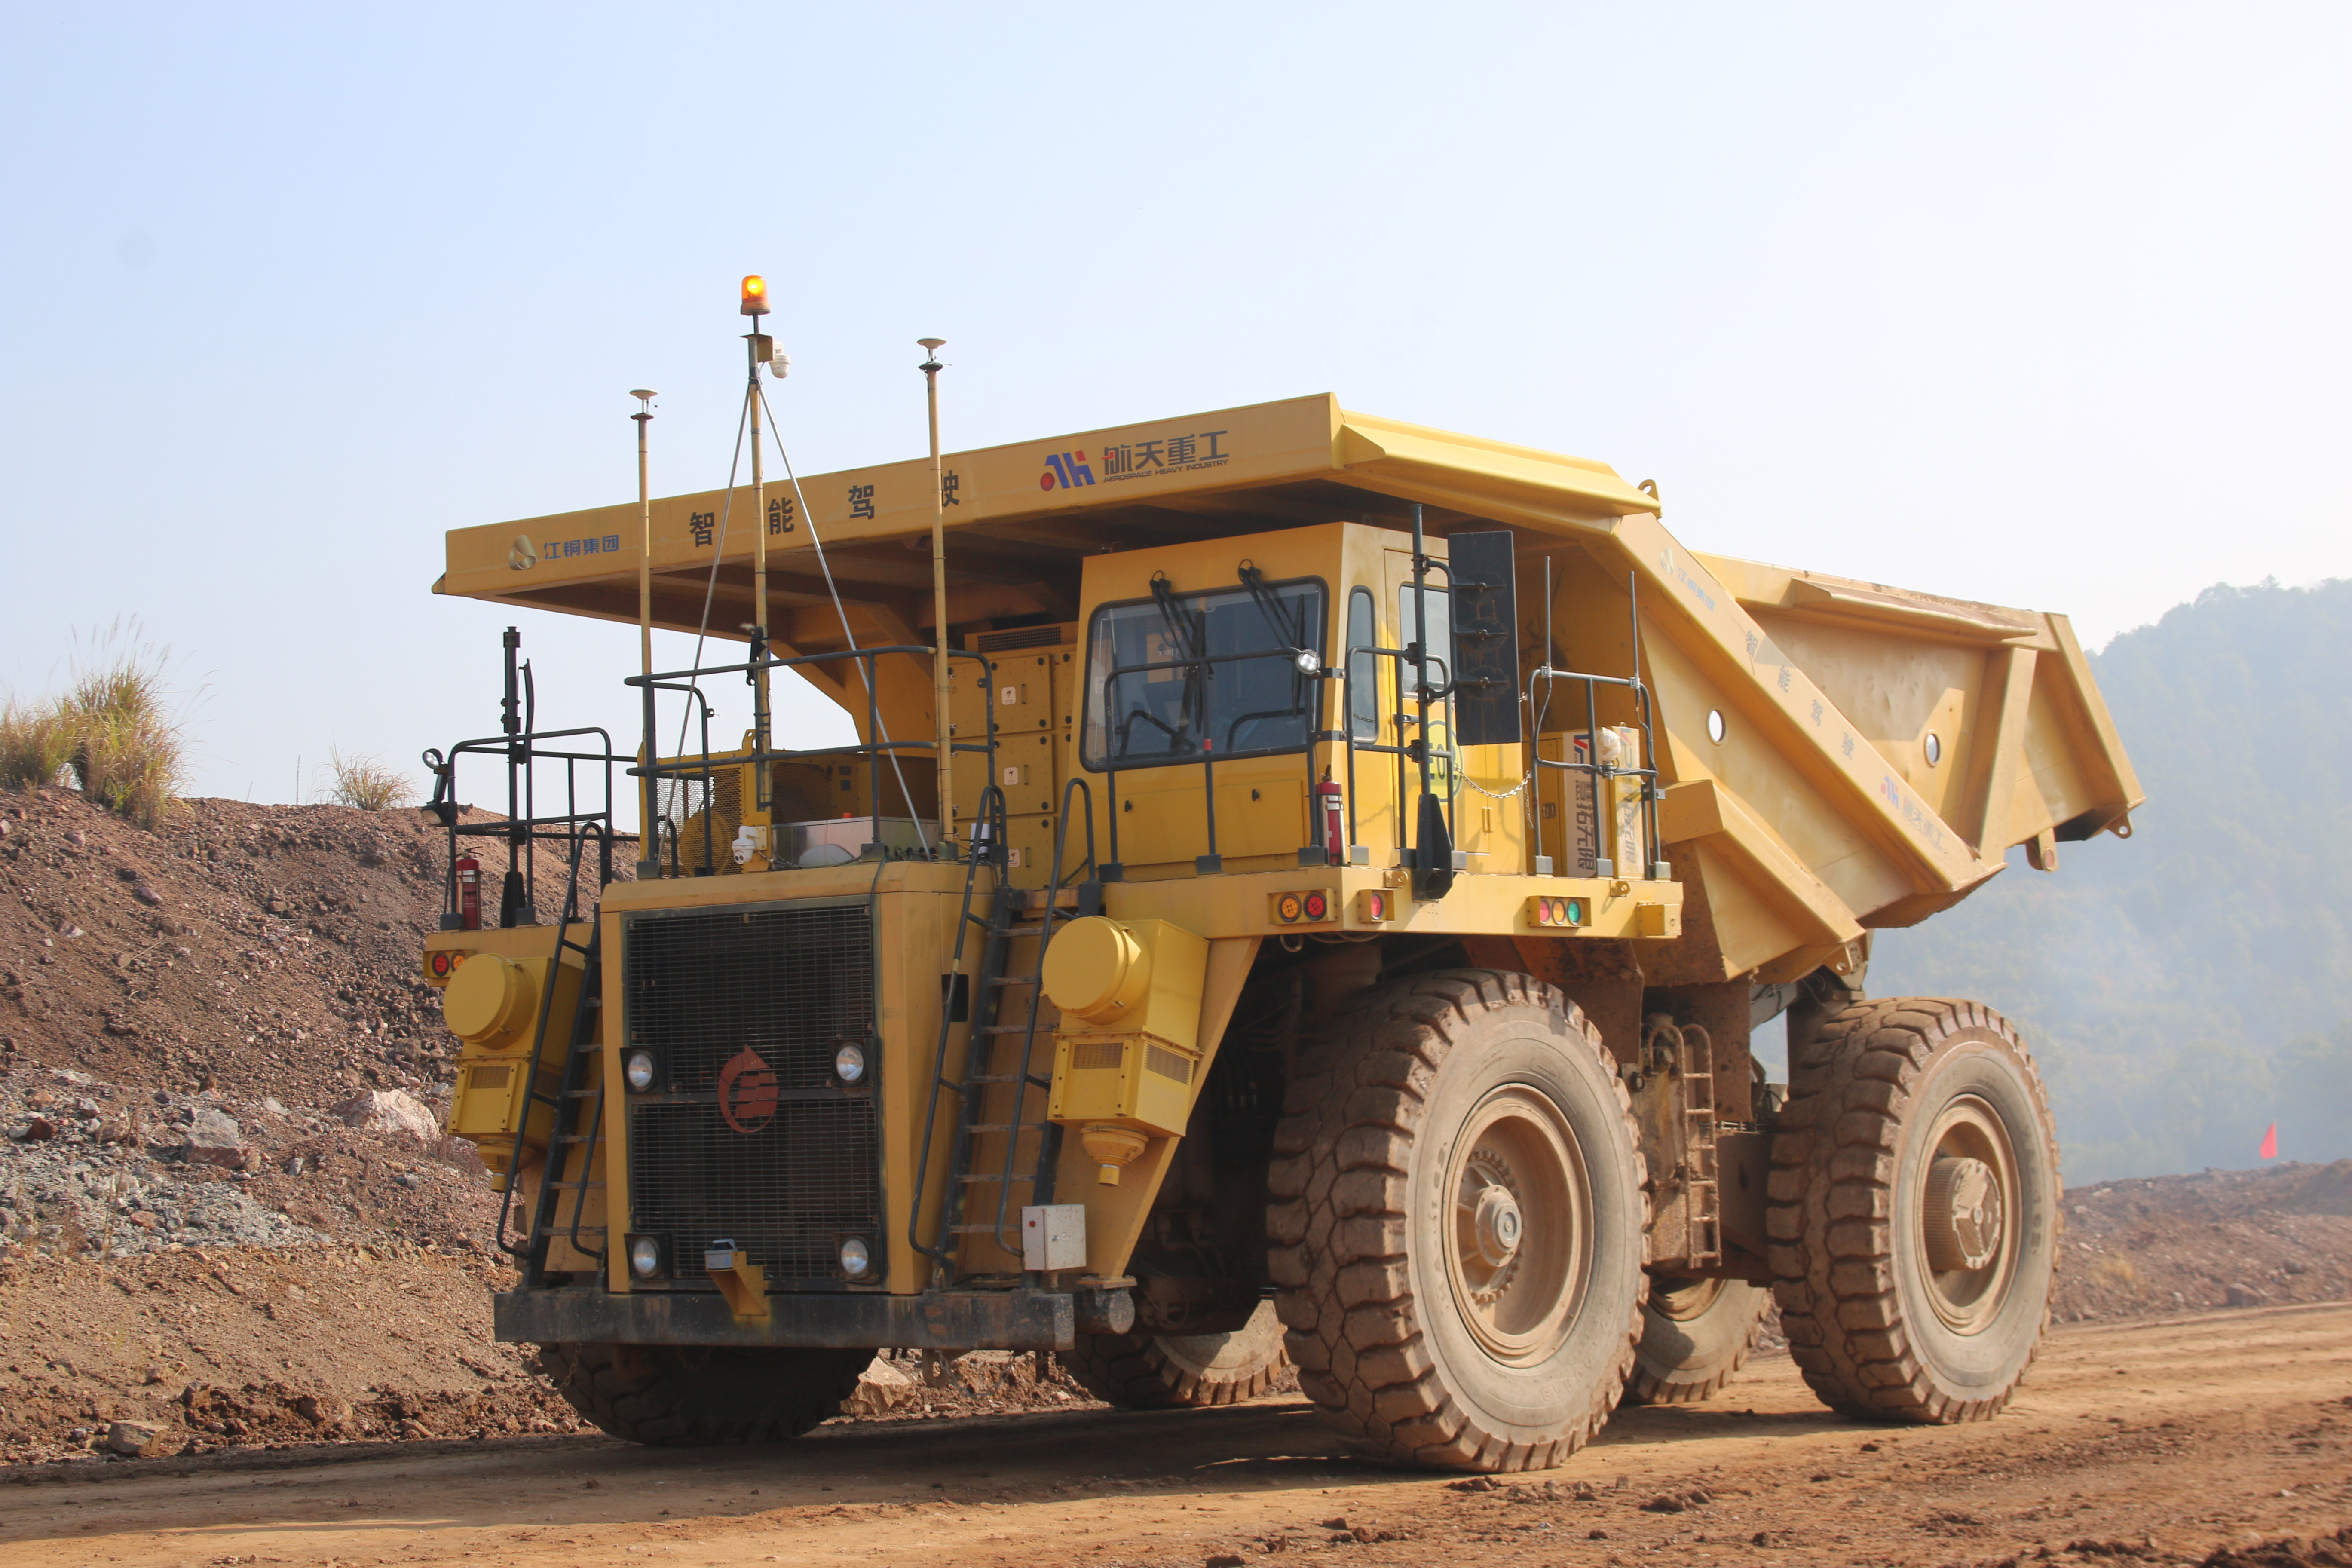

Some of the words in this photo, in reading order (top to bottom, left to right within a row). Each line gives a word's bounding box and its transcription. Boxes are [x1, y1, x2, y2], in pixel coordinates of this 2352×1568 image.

[1101, 430, 1229, 475] 航天重工
[1103, 470, 1152, 483] AEROSPACE
[1155, 466, 1183, 475] HEAVY
[1186, 459, 1228, 471] INDUSTRY
[543, 534, 619, 560] 江铜集团
